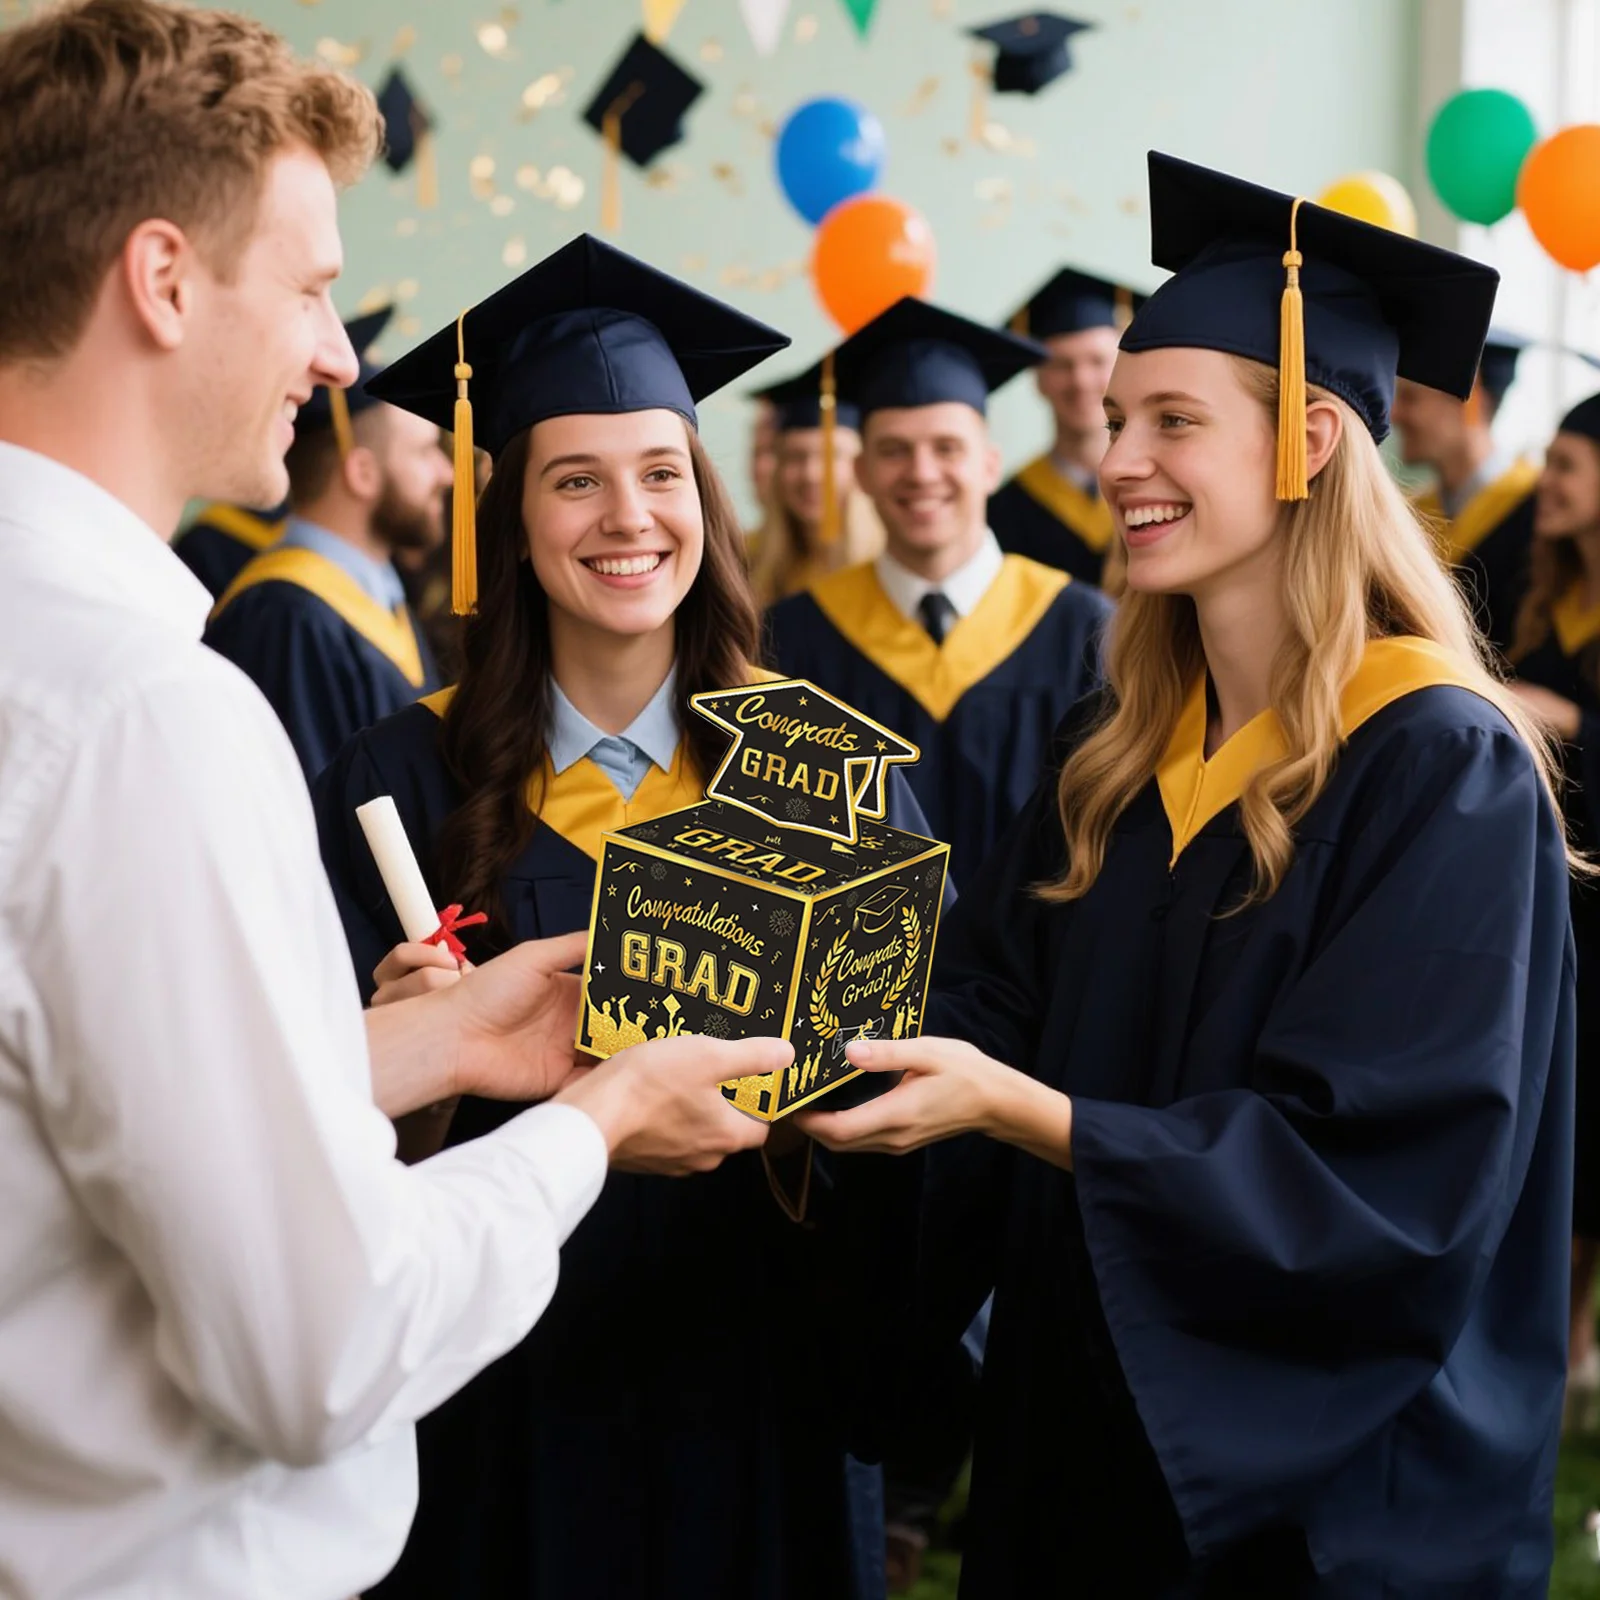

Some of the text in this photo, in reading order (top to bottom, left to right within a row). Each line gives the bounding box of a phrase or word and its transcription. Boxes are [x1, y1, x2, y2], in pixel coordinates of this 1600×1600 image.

[735, 695, 860, 752] Congrats
[740, 747, 840, 801] GRAD
[673, 828, 826, 883] GRAD
[626, 885, 765, 957] Congratulations
[620, 929, 761, 1017] GRAD
[836, 935, 904, 982] Congrats
[842, 964, 893, 1008] Grad!
